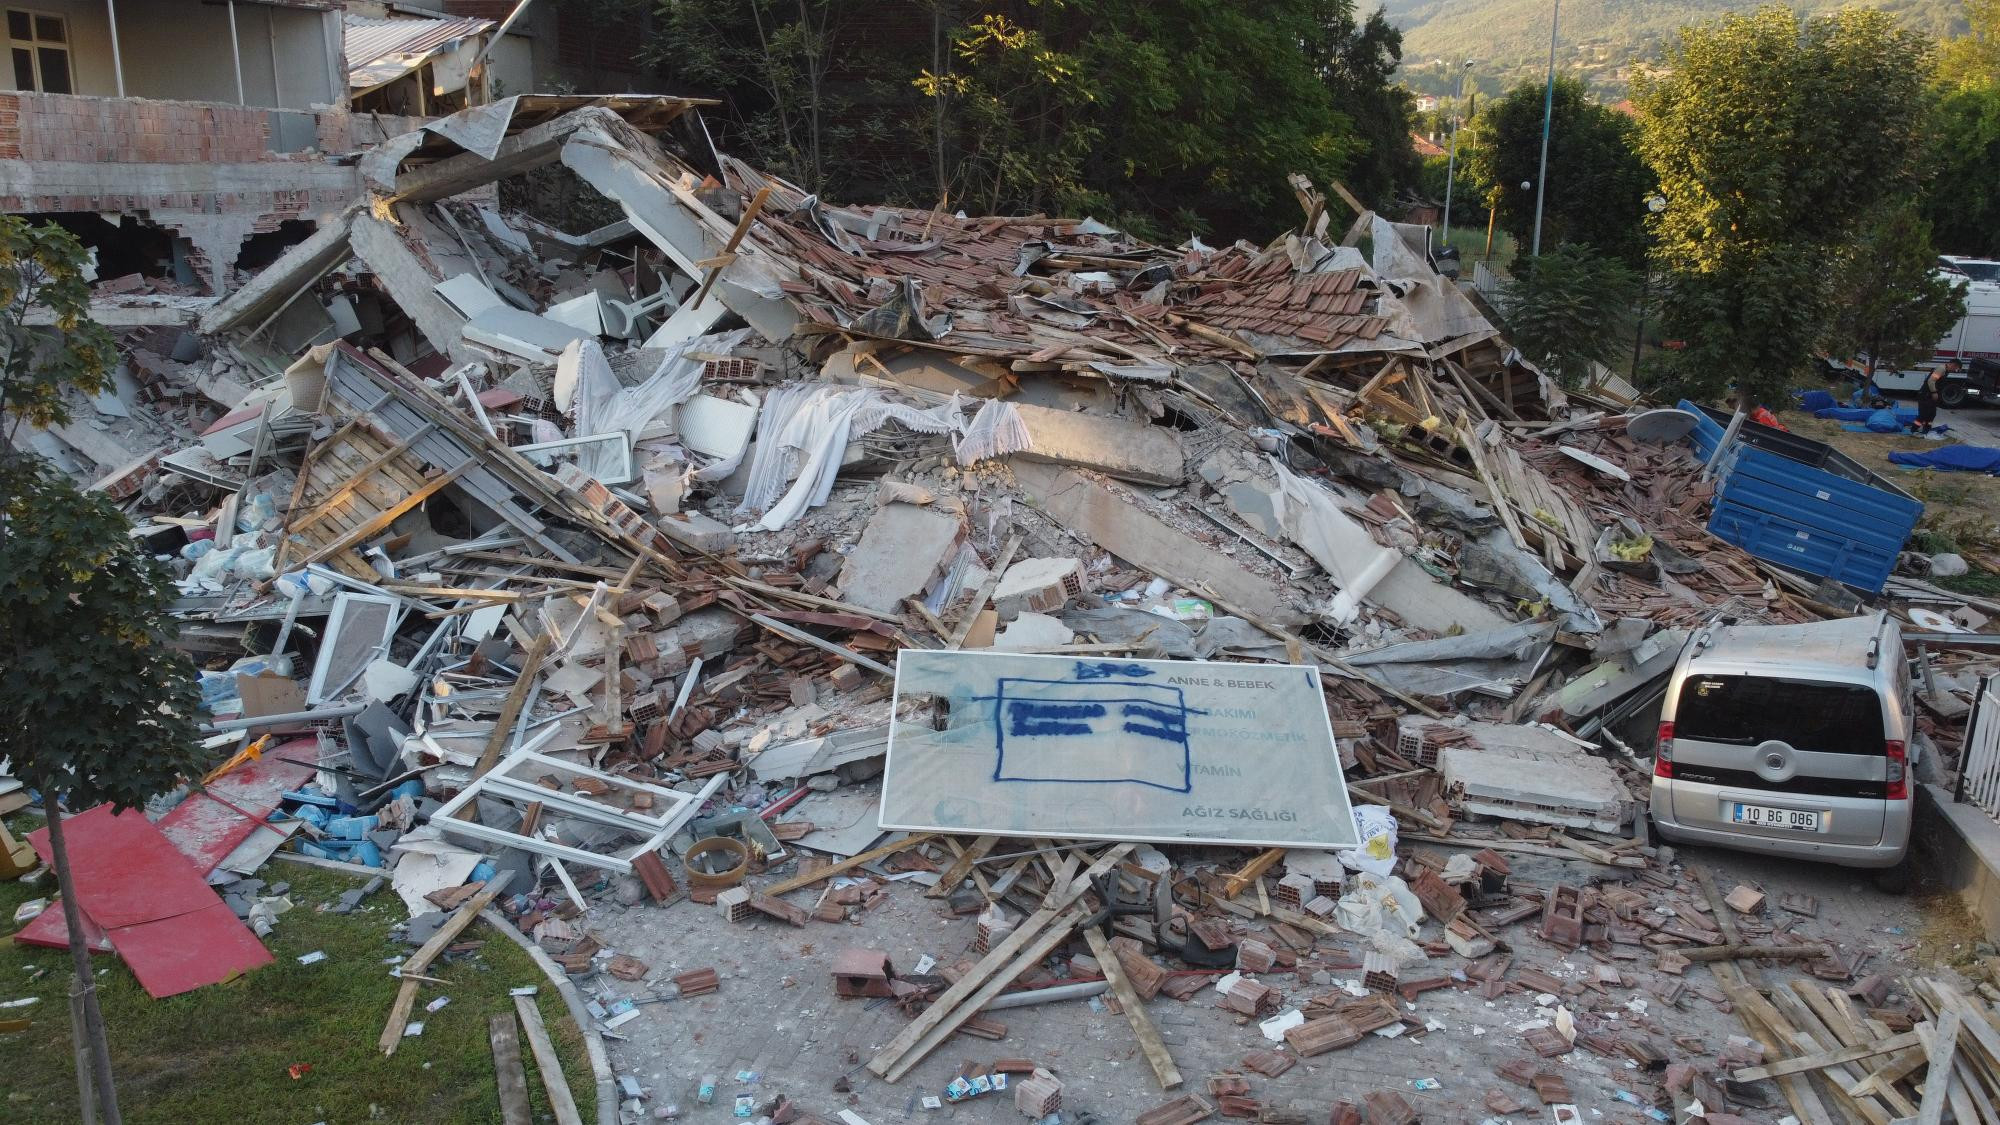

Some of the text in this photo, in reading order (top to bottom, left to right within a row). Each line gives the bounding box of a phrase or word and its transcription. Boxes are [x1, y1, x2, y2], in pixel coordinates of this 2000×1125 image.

[1167, 676, 1276, 690] ANNE & BEBEK
[1177, 762, 1241, 777] VTAMİN
[1182, 805, 1297, 821] AĞIZ SAĞLIĞI
[1747, 807, 1760, 820] 10
[1768, 809, 1782, 822] BG
[1790, 812, 1813, 826] 086
